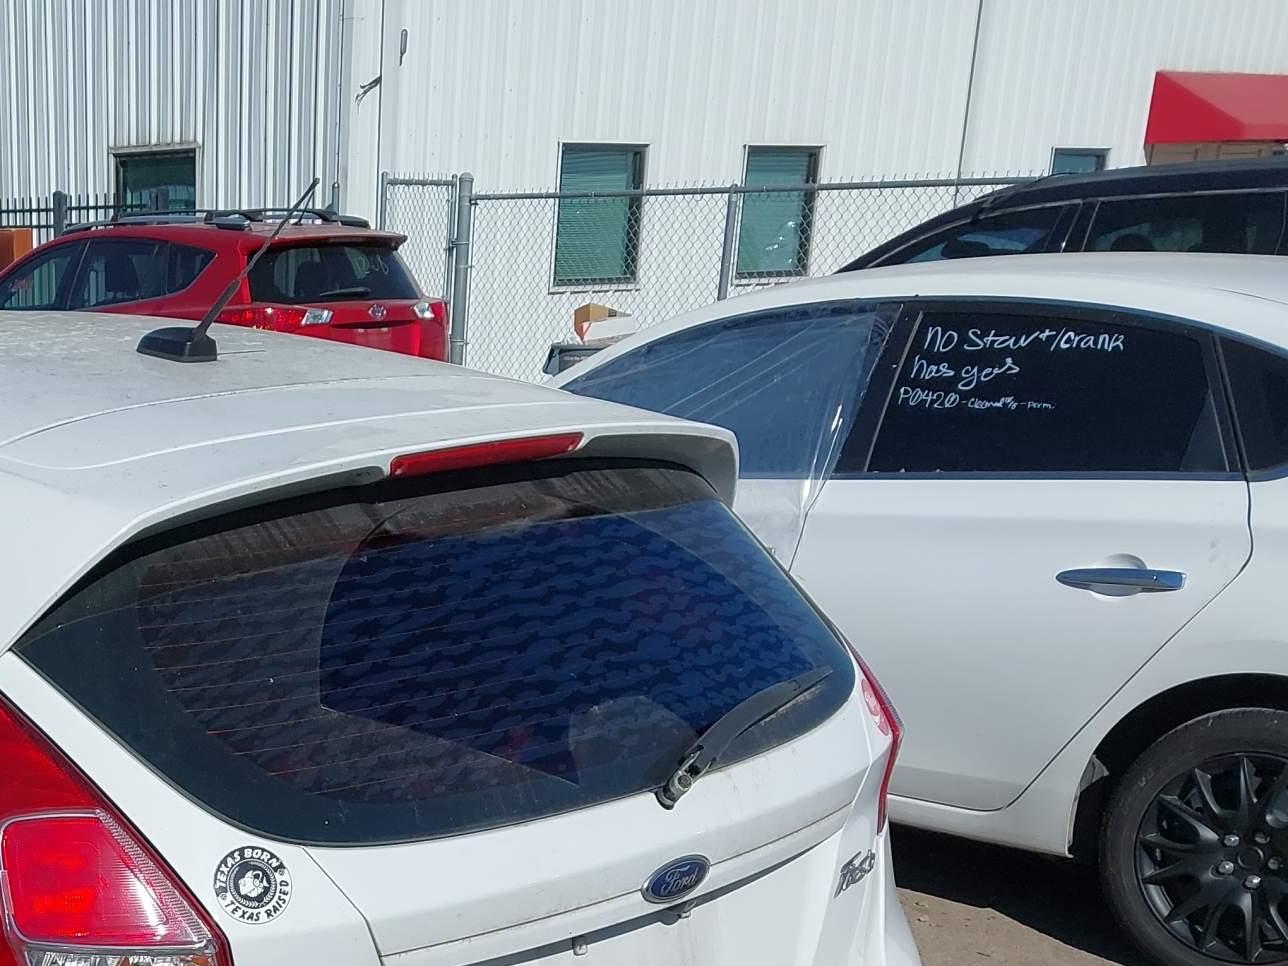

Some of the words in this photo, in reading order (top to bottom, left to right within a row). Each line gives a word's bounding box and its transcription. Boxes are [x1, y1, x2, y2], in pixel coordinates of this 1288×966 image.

[910, 354, 955, 380] has
[215, 851, 241, 889] TEXAS
[244, 848, 281, 867] BORN
[224, 900, 261, 921] TEXAS
[264, 880, 289, 919] RAISED
